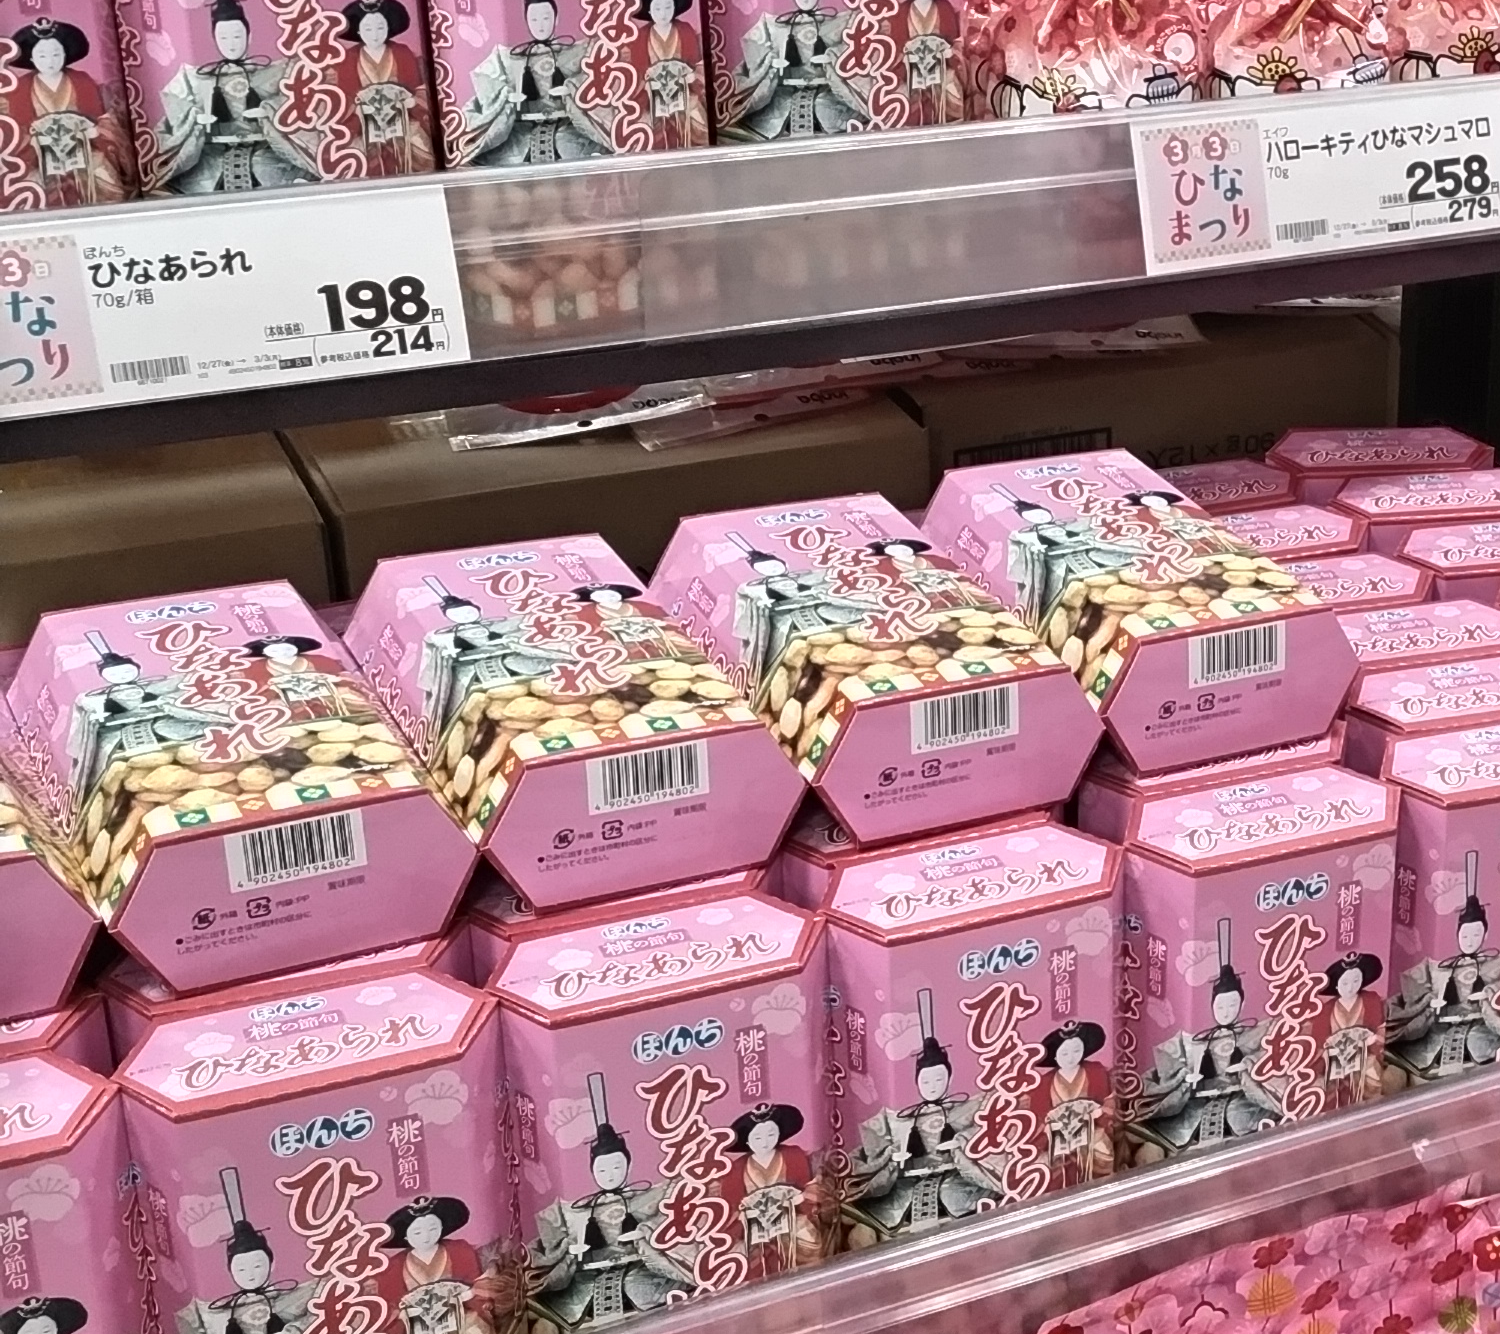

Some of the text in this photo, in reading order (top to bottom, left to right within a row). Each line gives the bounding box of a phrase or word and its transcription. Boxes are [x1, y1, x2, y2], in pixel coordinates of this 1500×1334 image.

[1262, 126, 1289, 139] エイワ
[1265, 116, 1491, 164] ハローキティひなマシュマロ
[1174, 164, 1244, 207] ひな
[1266, 166, 1290, 180] 70g
[1168, 204, 1251, 246] まつり
[90, 247, 253, 288] ひなあられ
[93, 288, 155, 309] 70g/箱
[1030, 473, 1202, 587] ひなあられ
[769, 523, 938, 644] ひなあられ
[470, 567, 633, 695] ひなあられ
[135, 620, 292, 764] ひなあられ
[608, 785, 696, 810] 902450 194802
[1181, 796, 1373, 853] ひなあられ
[251, 857, 352, 886] 902450 194802
[878, 856, 1088, 920] ひなあられ
[1256, 872, 1330, 912] ほんち
[1336, 883, 1362, 947] 桃の節句
[542, 932, 779, 999] ひなあられ
[958, 938, 1040, 982] ほんち
[1049, 947, 1077, 1015] 桃の節句
[178, 1011, 441, 1092] ひなあられ
[632, 1015, 725, 1064] ほんち
[735, 1028, 765, 1098] 桃の節句
[270, 1109, 375, 1157] ほんち
[387, 1115, 422, 1190] 桃の節句
